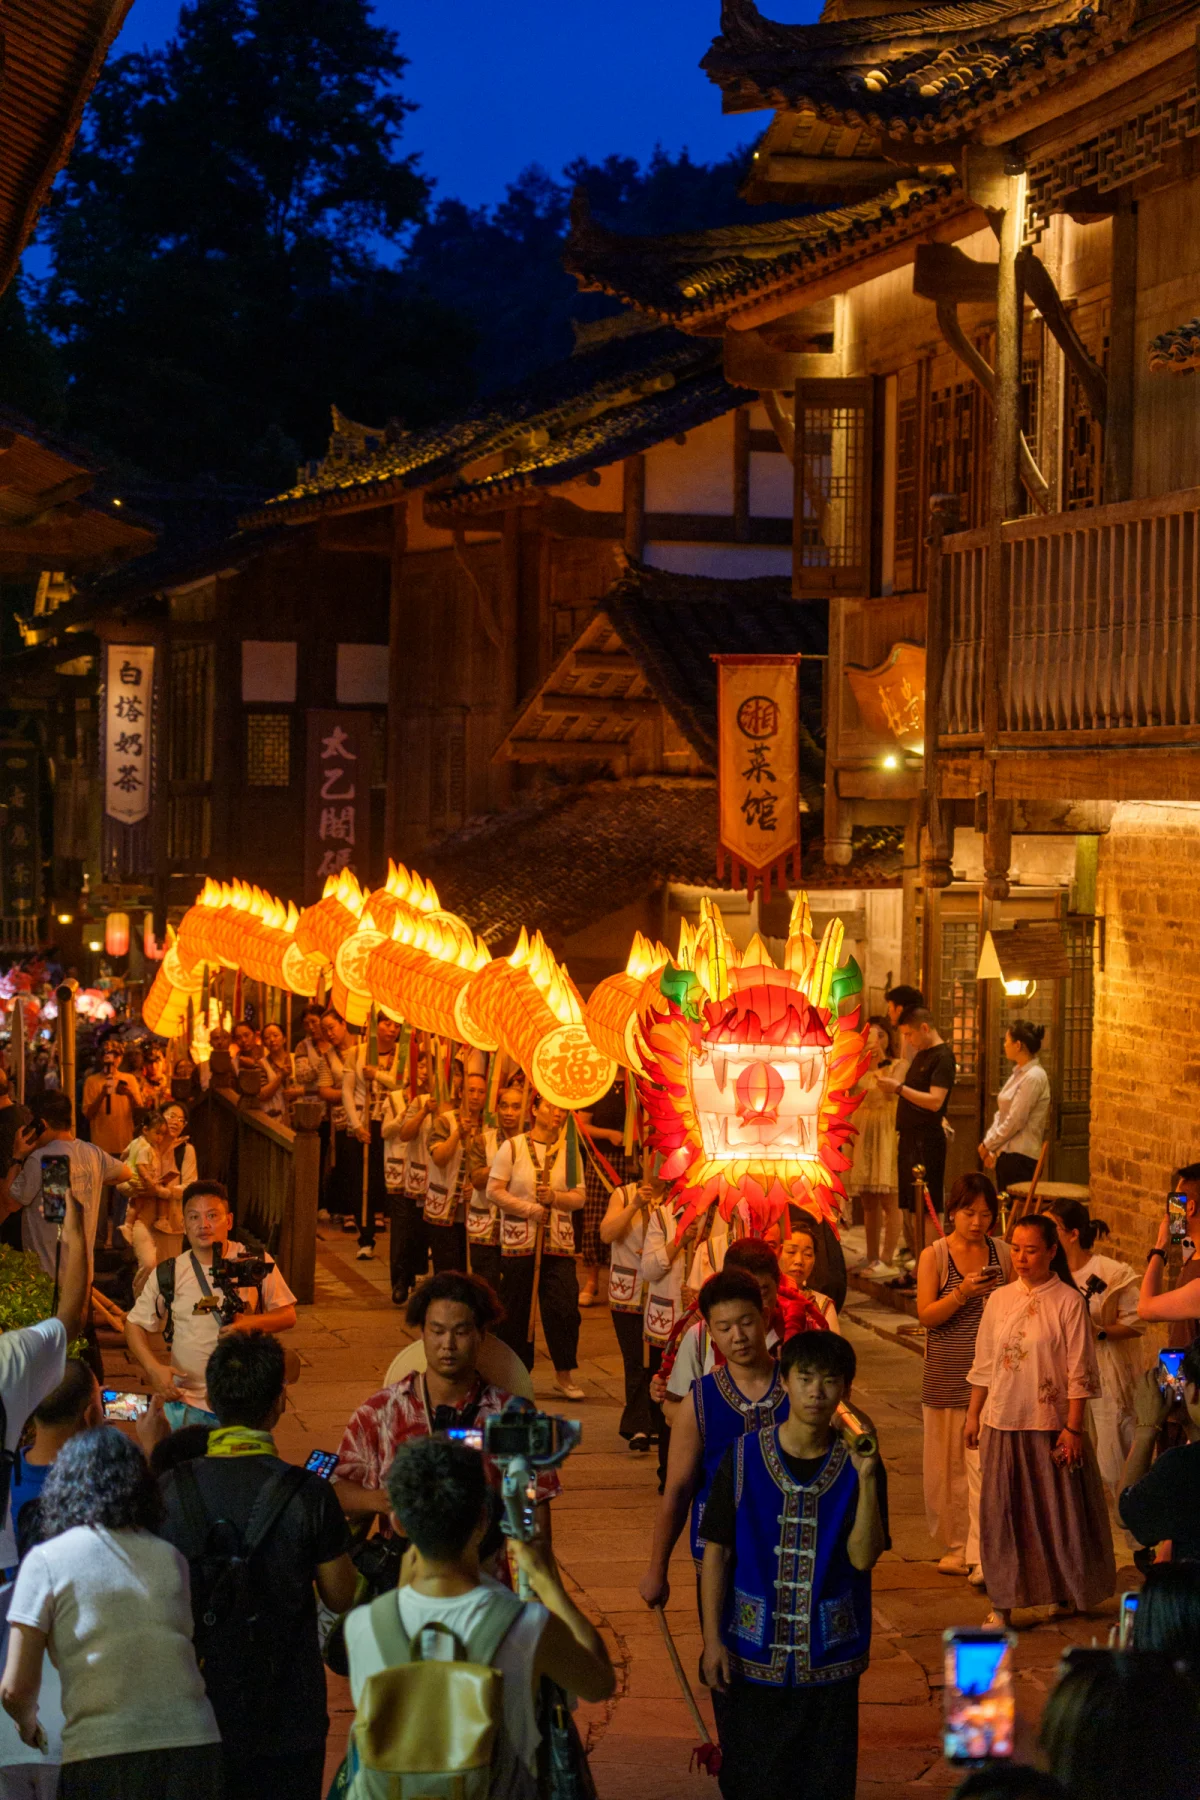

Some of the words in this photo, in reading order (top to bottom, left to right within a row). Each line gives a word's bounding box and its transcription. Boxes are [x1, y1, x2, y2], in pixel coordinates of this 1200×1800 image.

[738, 697, 779, 831] 湘菜馆
[550, 1041, 598, 1085] 福
